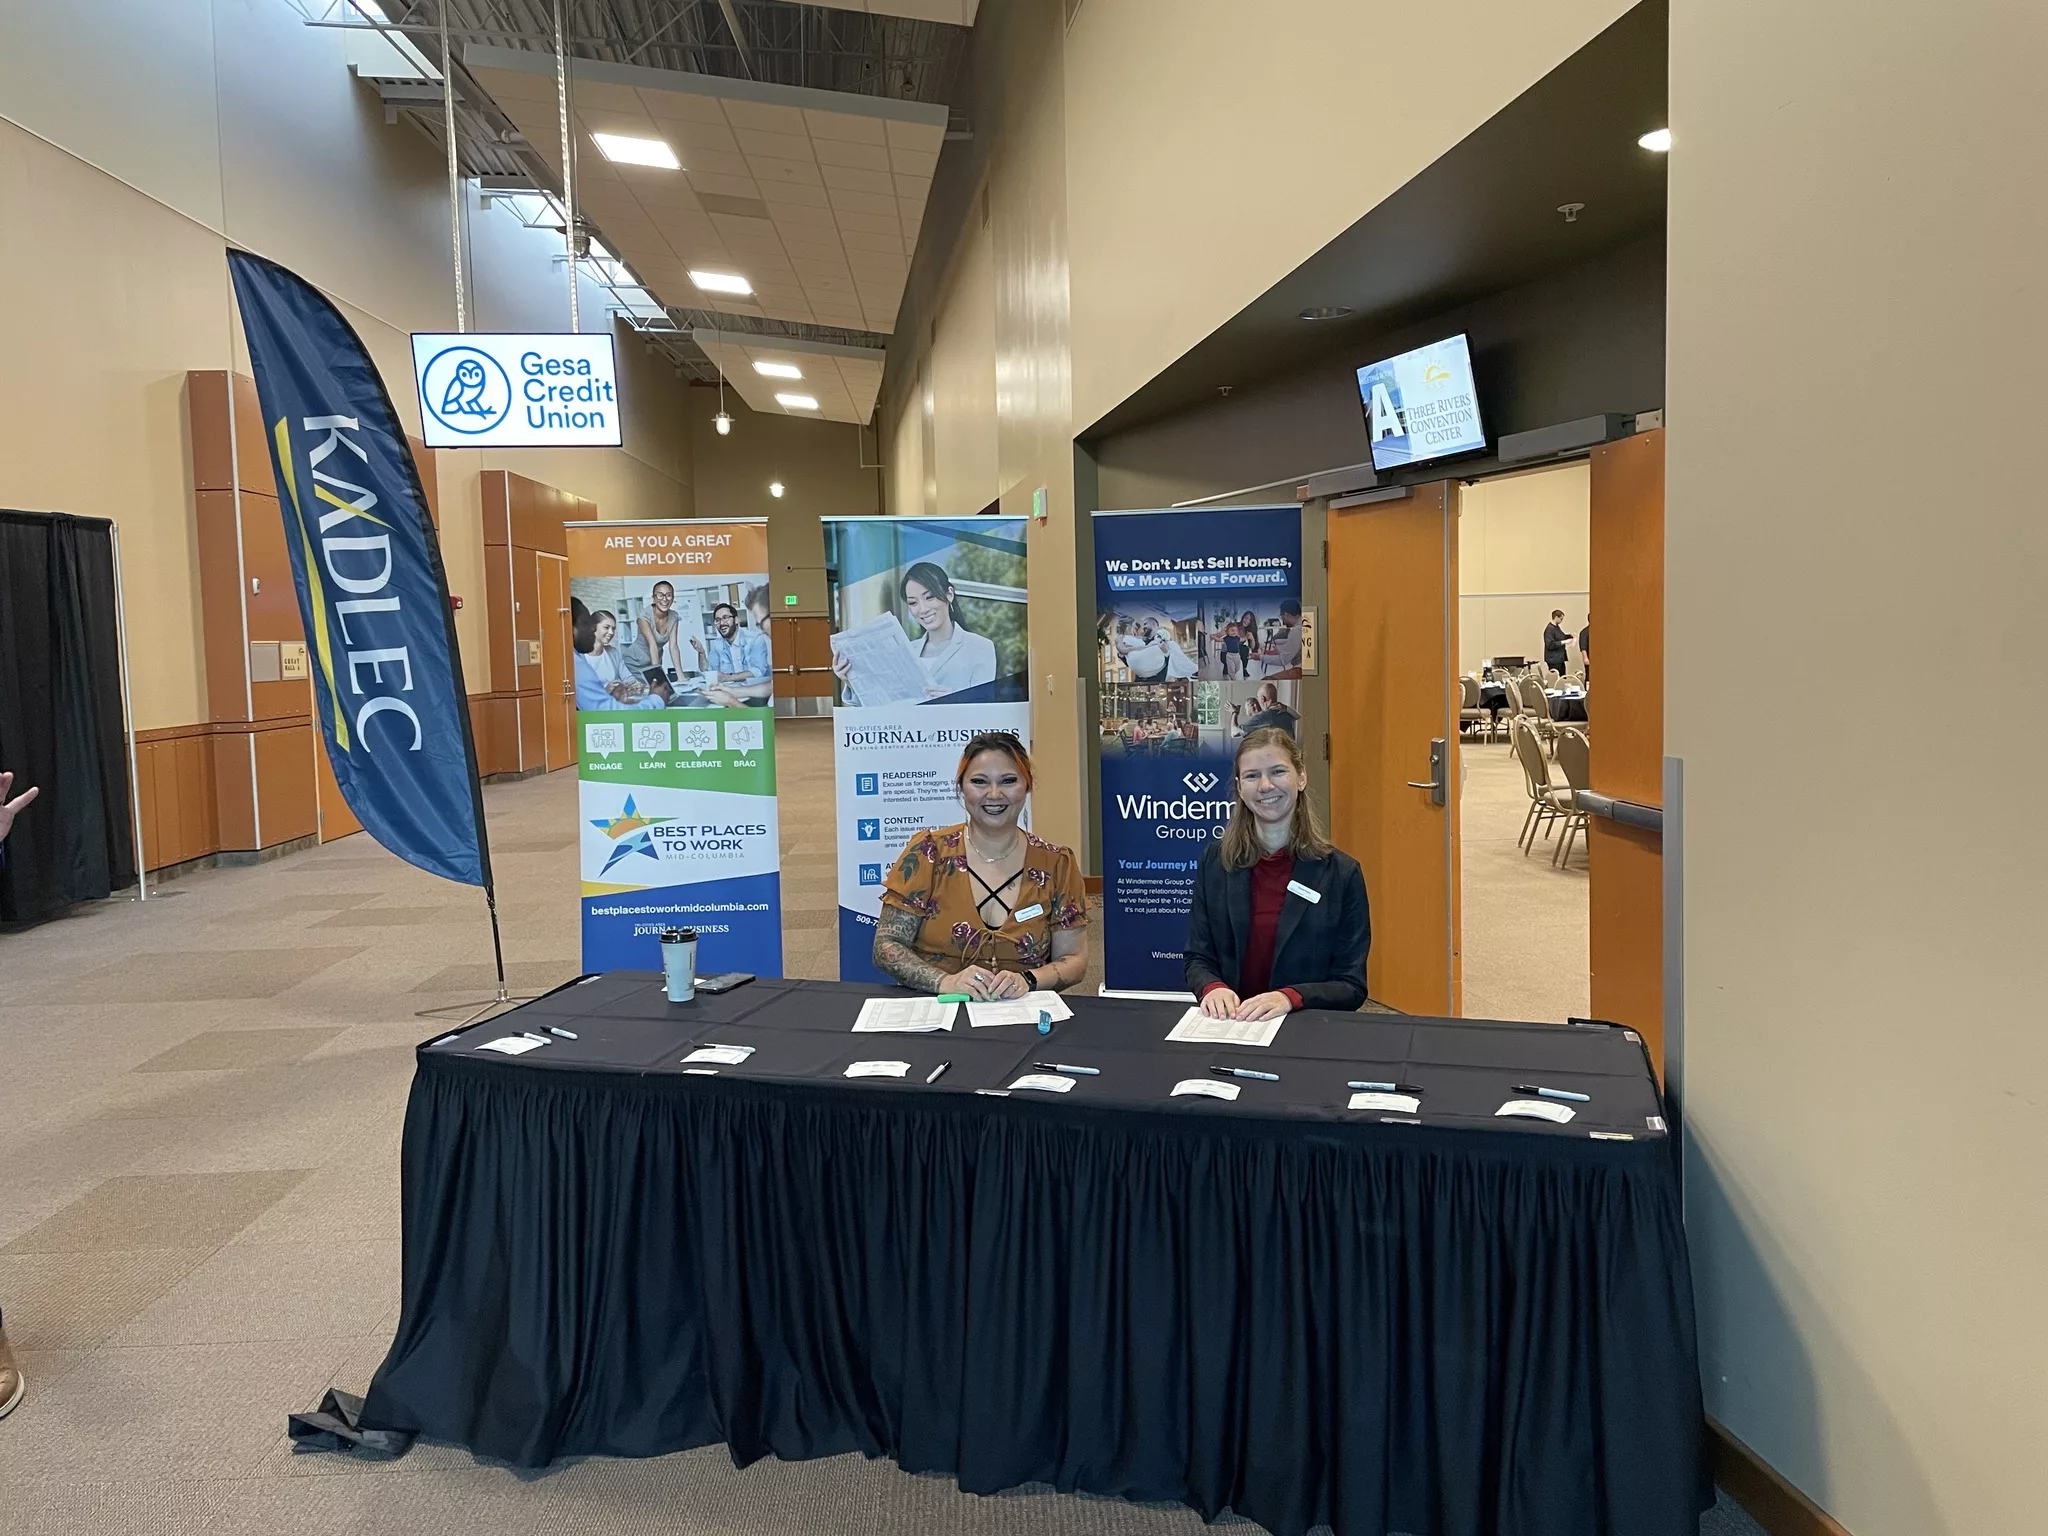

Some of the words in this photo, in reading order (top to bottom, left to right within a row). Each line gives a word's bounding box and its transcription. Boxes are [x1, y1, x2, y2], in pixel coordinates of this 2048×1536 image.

[520, 351, 591, 376] Gesa
[523, 378, 614, 403] Credit
[1372, 382, 1405, 443] A
[1406, 402, 1437, 420] THREE
[1437, 393, 1472, 413] RIVERS
[526, 405, 605, 429] Union
[1410, 407, 1473, 434] CONVENTION
[1425, 426, 1463, 445] CENTER
[604, 536, 634, 549] ARE
[637, 535, 668, 548] YOU
[672, 535, 682, 547] A
[685, 534, 733, 547] GREAT
[625, 552, 713, 565] EMPLOYER?
[1105, 560, 1129, 572] We
[1131, 558, 1171, 571] Don't
[1173, 557, 1204, 570] Just
[1207, 556, 1234, 569] Sell
[1237, 556, 1292, 569] Homes,
[303, 414, 422, 753] KADLEC
[1112, 575, 1136, 587] We
[1139, 574, 1177, 587] Move
[1180, 573, 1217, 586] Lives
[1220, 571, 1285, 585] Forward.
[844, 730, 927, 748] JOURNAL
[927, 732, 936, 741] of
[589, 762, 623, 771] ENGAGE
[639, 761, 666, 769] LEARN
[675, 760, 722, 769] CELEBRATE
[733, 760, 756, 768] BRAG
[882, 771, 937, 779] READERSHIP
[1116, 794, 1237, 820] Winderm
[884, 816, 924, 825] CONTENT
[653, 826, 698, 837] BEST
[701, 824, 767, 836] PLACES
[1155, 824, 1207, 842] Group
[663, 840, 687, 851] TO
[690, 839, 743, 850] WORK
[665, 852, 745, 860] MID-COLUMBIA
[1118, 859, 1144, 869] Your
[1145, 860, 1187, 872] Journey
[1138, 897, 1160, 905] helped
[591, 902, 769, 917] bestplacestoworkmidcolumbia.com
[1151, 951, 1184, 959] Winderm
